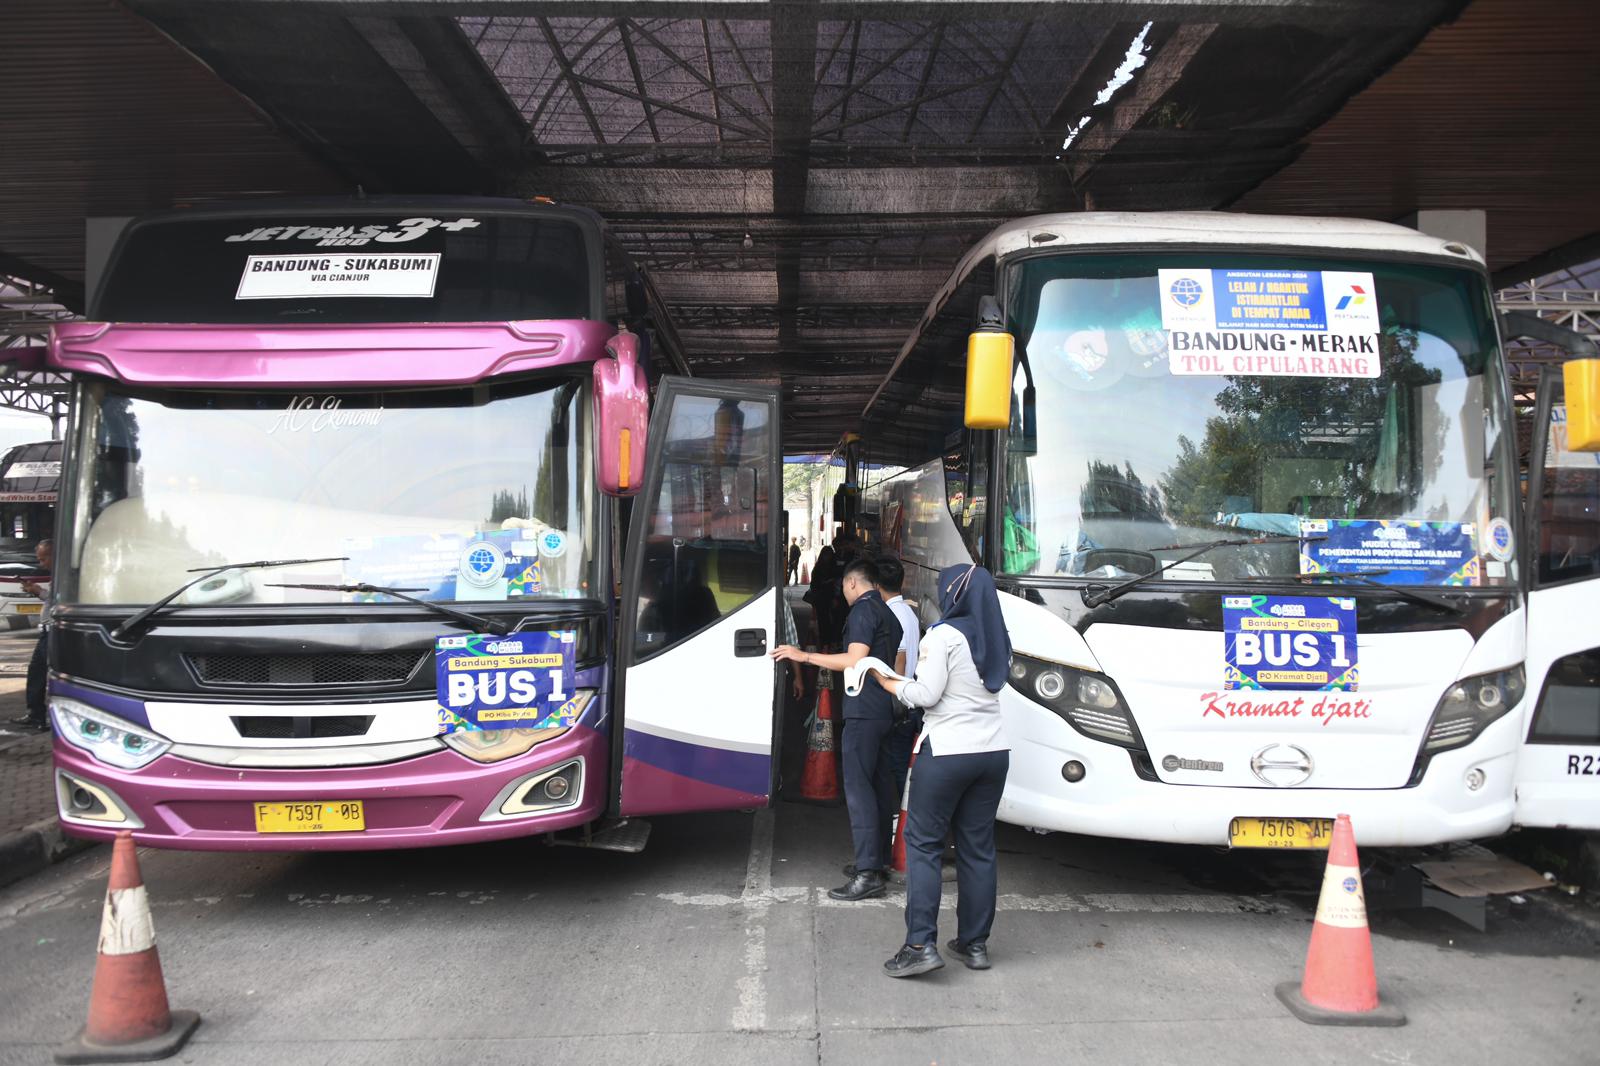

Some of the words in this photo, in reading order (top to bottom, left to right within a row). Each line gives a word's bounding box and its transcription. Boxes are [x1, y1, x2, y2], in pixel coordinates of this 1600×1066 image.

[251, 259, 331, 273] BANDUNG
[344, 258, 433, 271] SUKABUMI
[311, 273, 327, 282] VIA
[329, 273, 370, 282] CIANJUR
[1228, 281, 1257, 293] LELAH
[1231, 306, 1242, 318] DI
[1243, 307, 1280, 319] TEMPAT
[1282, 308, 1311, 320] AMAN
[1172, 331, 1286, 351] BANDUNG
[1302, 333, 1375, 354] MERAK
[1181, 355, 1225, 373] TOL
[1232, 355, 1369, 375] CIPULARANG
[266, 396, 315, 434] AC
[311, 395, 385, 433] Ekonomi
[0, 494, 36, 502] edWhite
[503, 556, 522, 565] RAT
[1248, 619, 1289, 629] Bandung
[1297, 619, 1332, 629] Cilegon
[1235, 633, 1320, 667] BUS
[1330, 634, 1350, 667] 1
[454, 659, 499, 668] Bandung
[508, 655, 558, 665] Sukabumi
[1306, 673, 1326, 682] Djati
[448, 669, 537, 707] BUS
[547, 669, 567, 702] 1
[1200, 691, 1305, 719] Kramat
[1311, 696, 1373, 727] djati
[1180, 758, 1223, 772] tentrem
[258, 805, 269, 822] F
[285, 804, 323, 822] 7597
[1260, 820, 1295, 838] 7576
